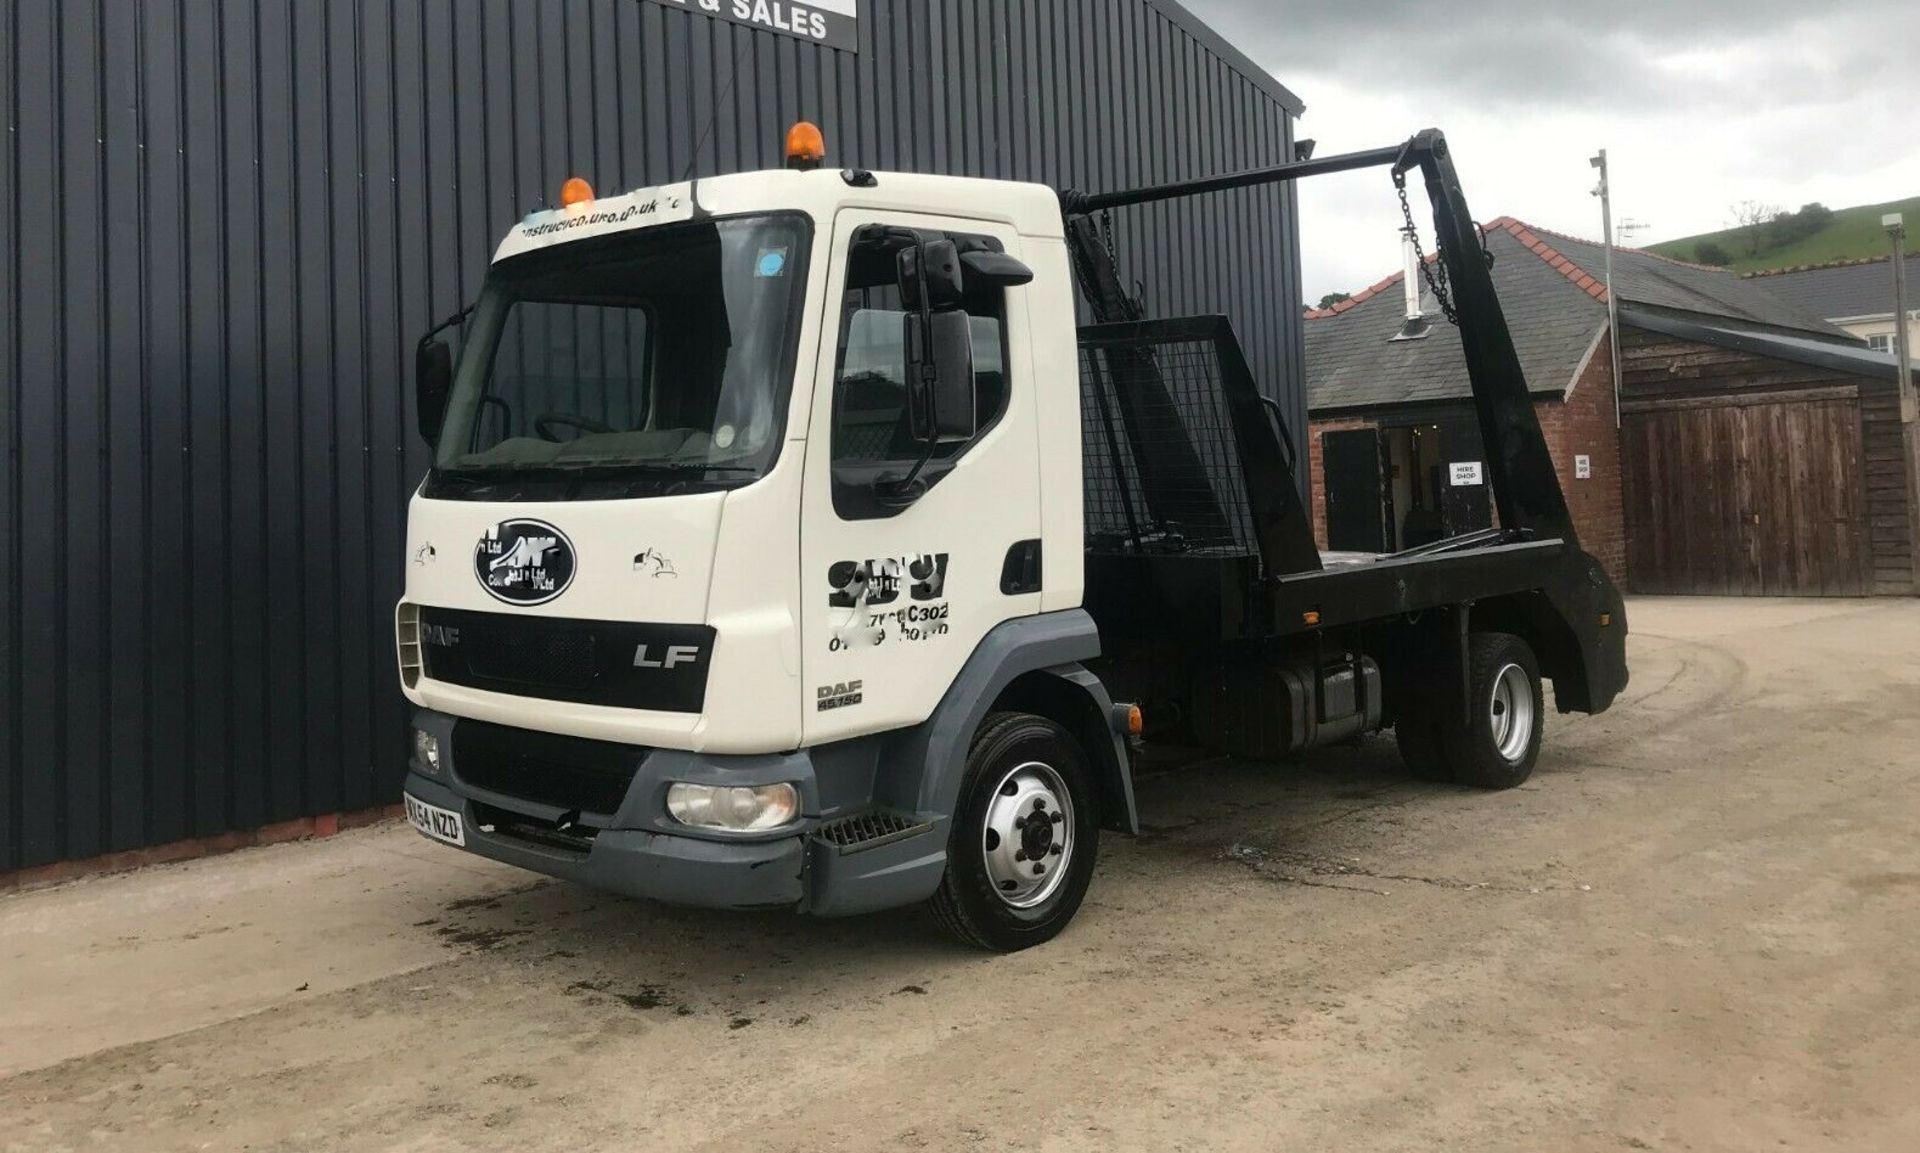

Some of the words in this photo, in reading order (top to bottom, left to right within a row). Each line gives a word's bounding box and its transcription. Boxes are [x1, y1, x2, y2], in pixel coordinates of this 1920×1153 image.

[732, 0, 827, 39] SALES
[633, 644, 699, 669] LF
[817, 679, 863, 699] DAF
[432, 809, 458, 839] NZD
